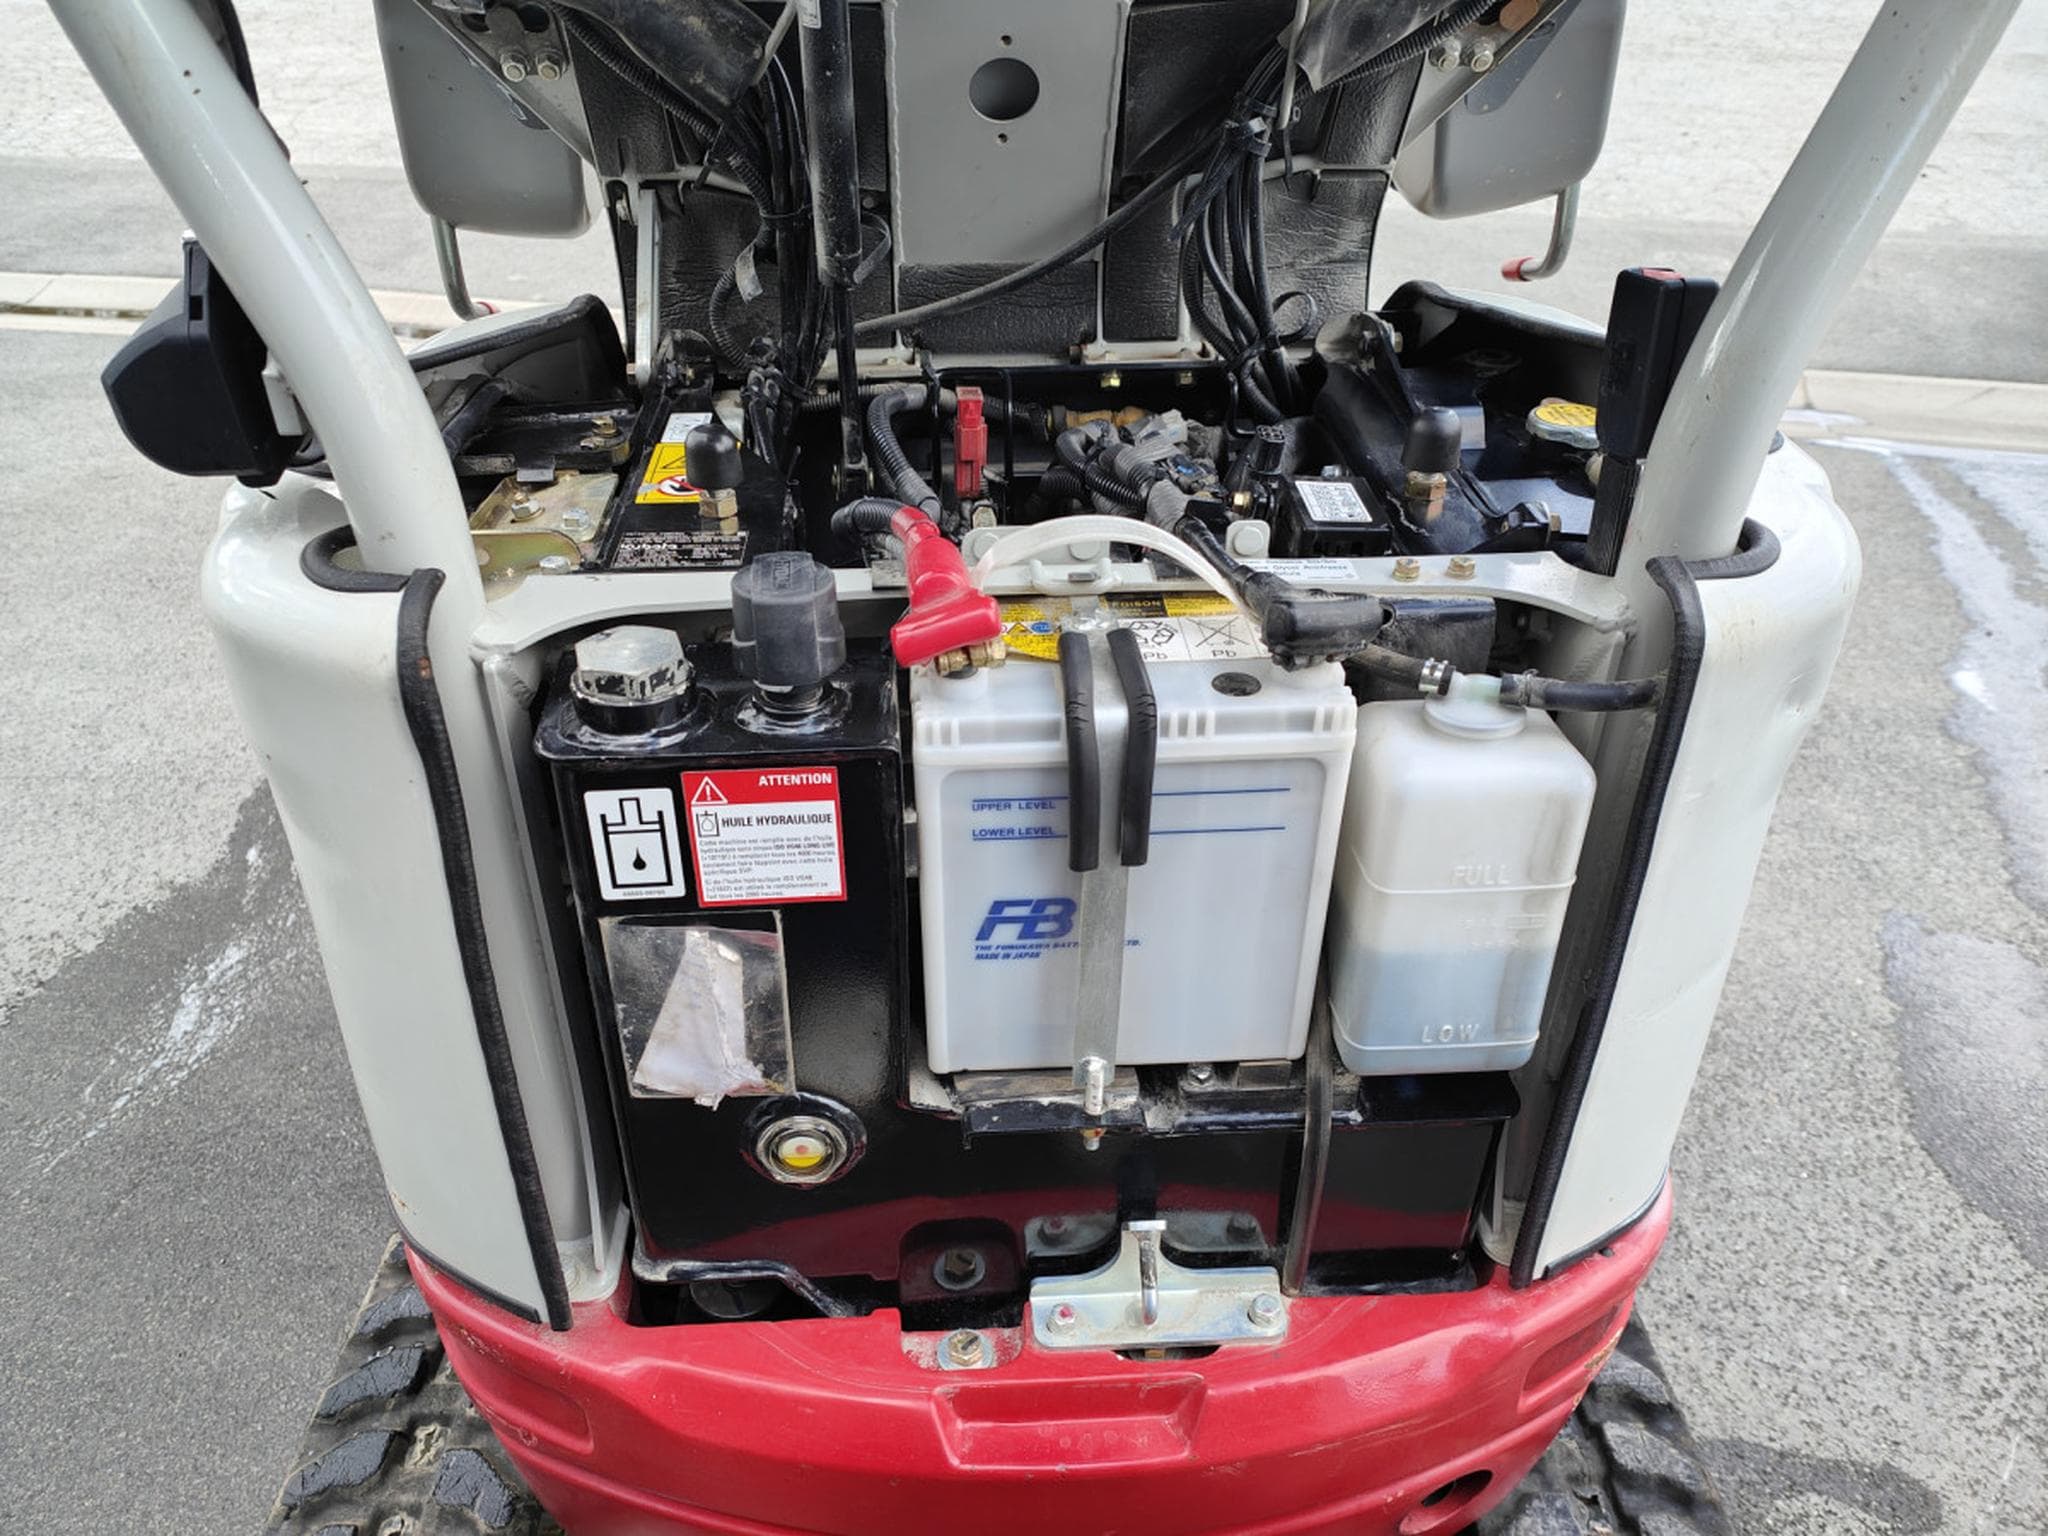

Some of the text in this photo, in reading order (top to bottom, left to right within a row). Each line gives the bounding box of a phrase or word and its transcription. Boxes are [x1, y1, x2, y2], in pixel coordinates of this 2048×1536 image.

[1143, 652, 1168, 660] Pb
[1211, 650, 1237, 658] Pb
[758, 773, 832, 787] ATTENTION
[972, 801, 1056, 811] UPPER LEVEL
[721, 812, 833, 828] HUILE HYDRAULIQUE
[972, 827, 1056, 837] LOWER LEVEL
[1450, 864, 1512, 886] FULL
[975, 897, 1077, 941] FB
[1124, 939, 1141, 947] TD.
[1013, 952, 1040, 960] JAPAN
[1421, 1024, 1480, 1043] LOW
